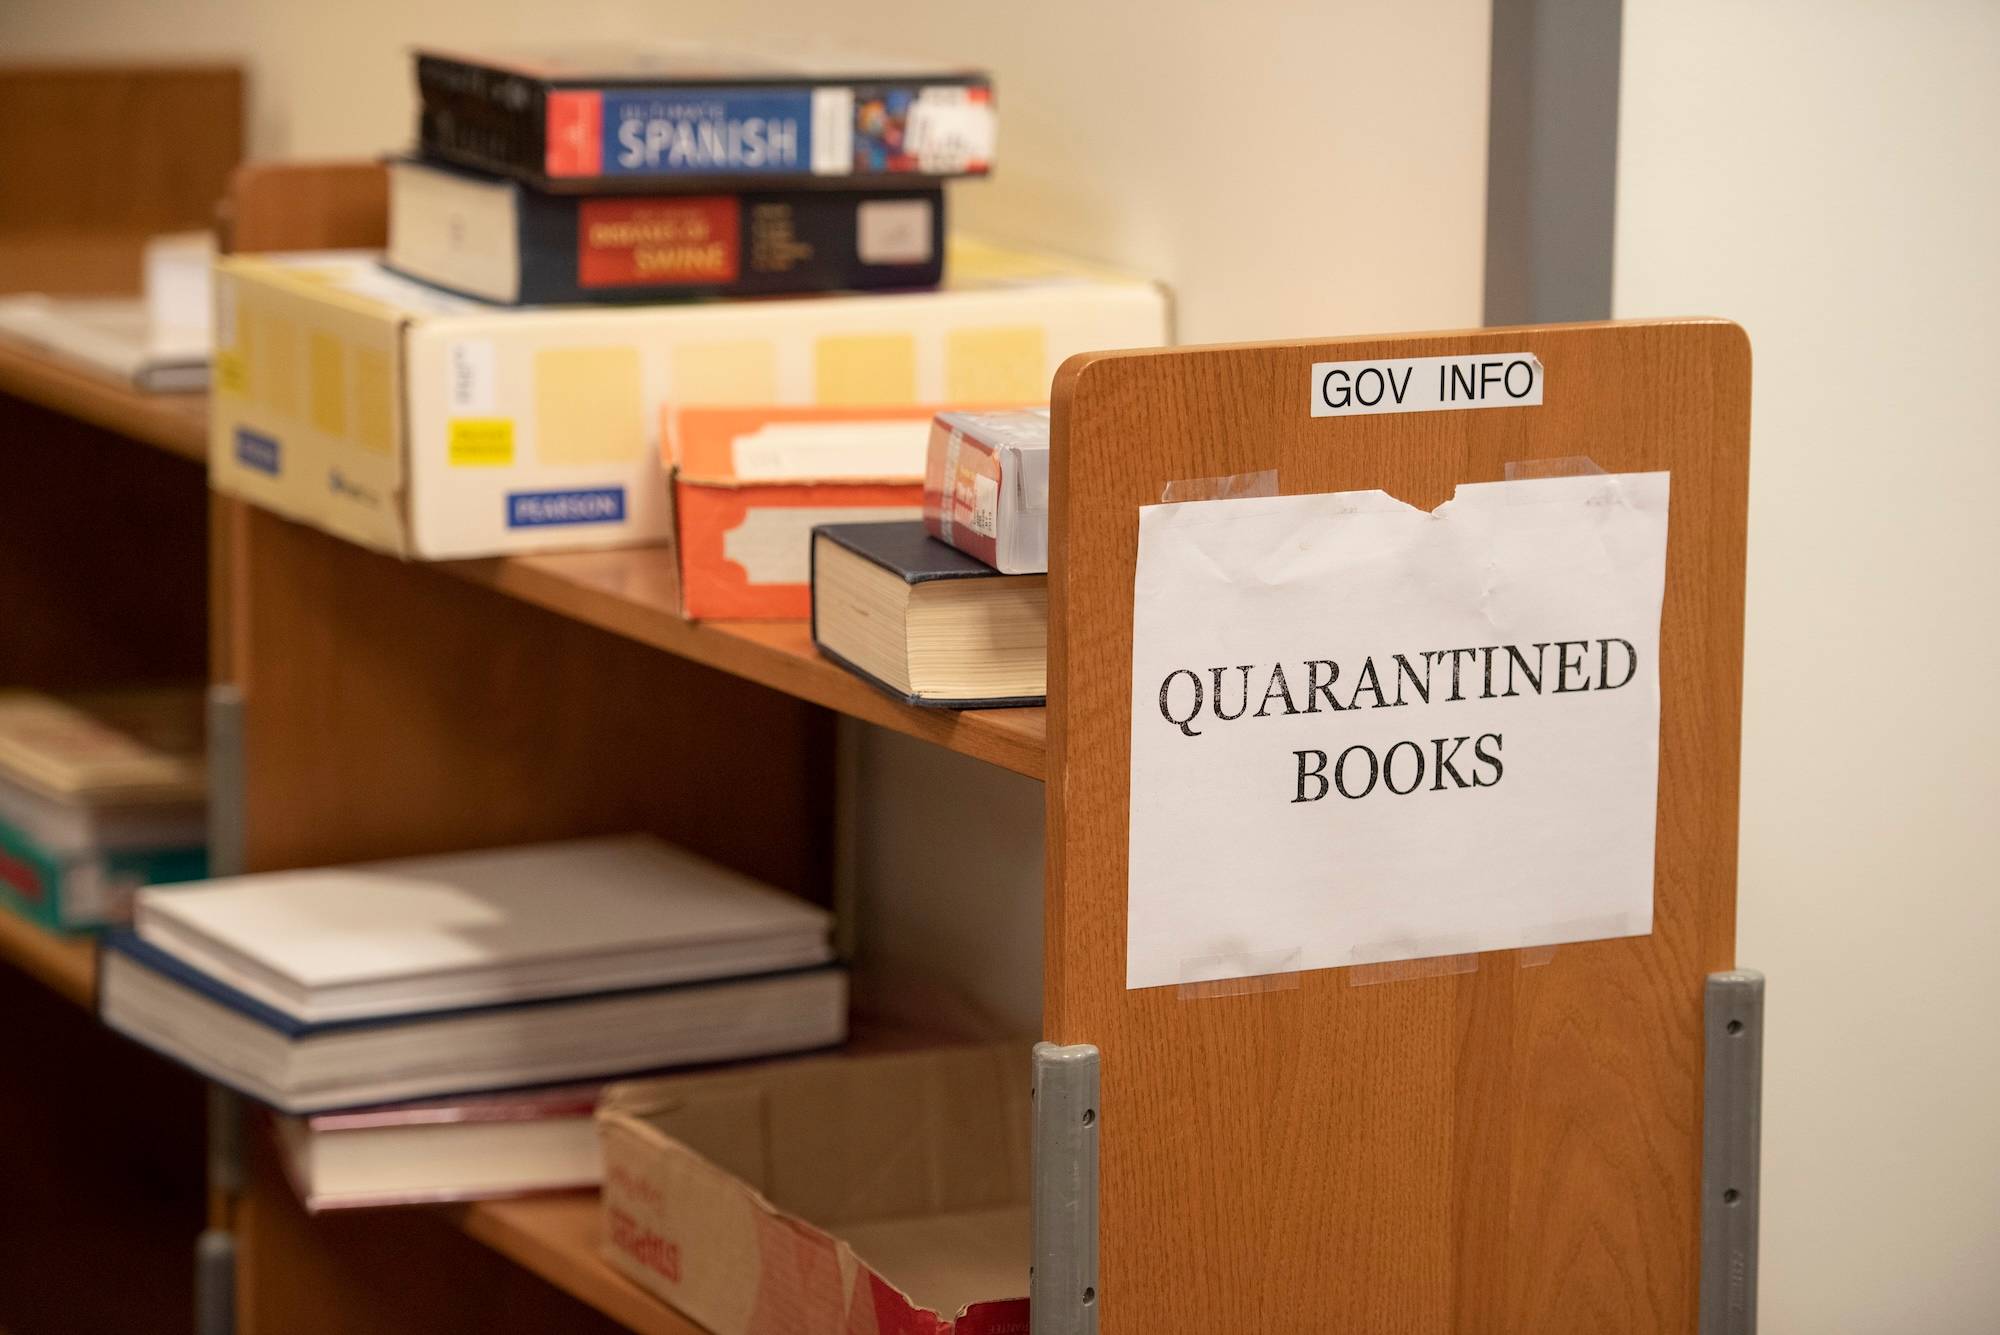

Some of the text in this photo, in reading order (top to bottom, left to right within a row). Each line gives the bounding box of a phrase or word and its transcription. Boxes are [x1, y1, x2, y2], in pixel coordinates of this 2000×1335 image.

[618, 117, 798, 169] SPANISH
[633, 243, 724, 277] SWINE
[1322, 360, 1534, 410] GOV INFO
[514, 496, 618, 522] PEARSON
[1158, 637, 1638, 738] QUARANTINED
[1290, 732, 1505, 805] BOOKS
